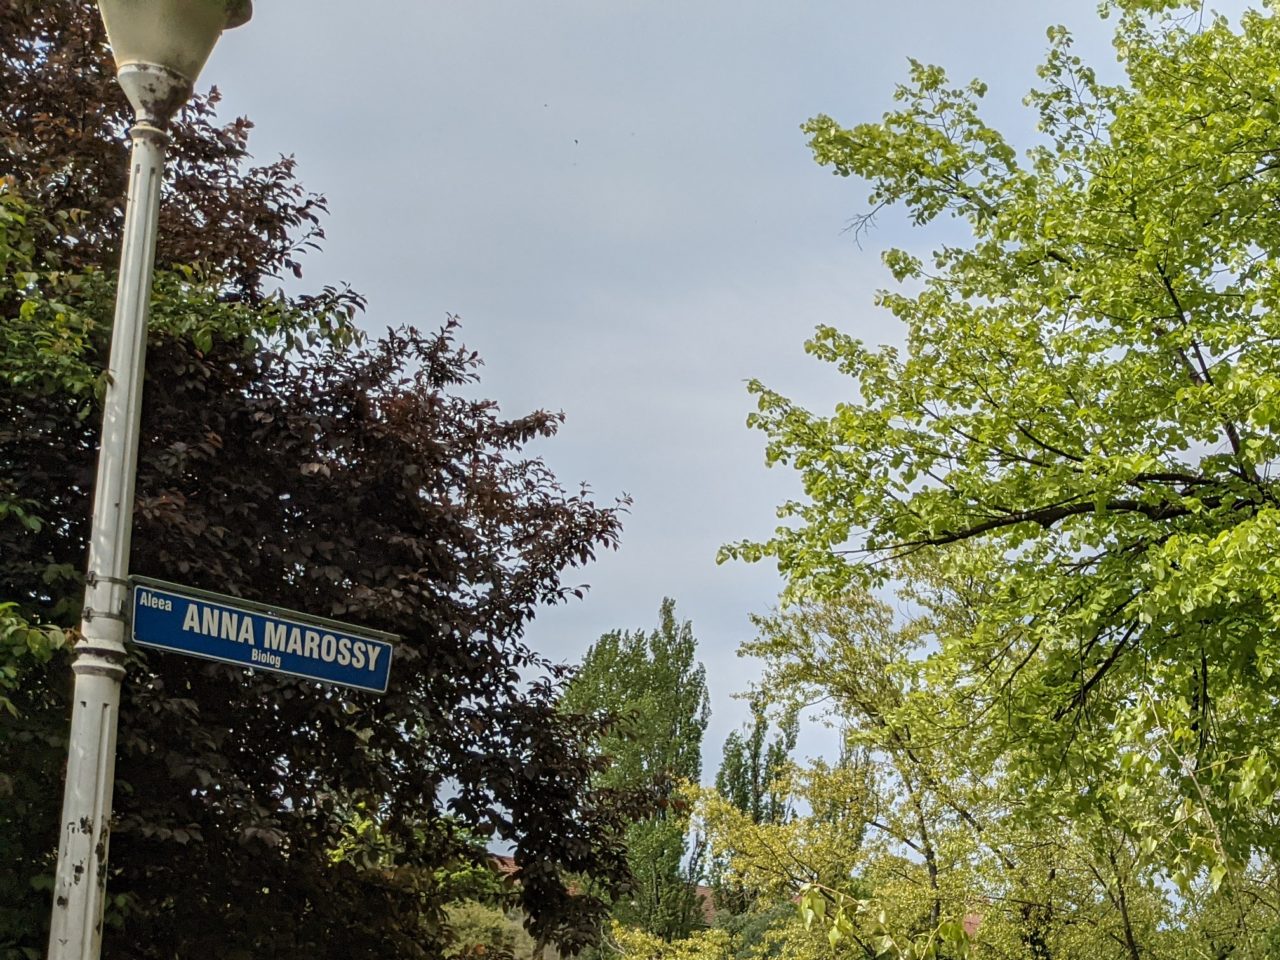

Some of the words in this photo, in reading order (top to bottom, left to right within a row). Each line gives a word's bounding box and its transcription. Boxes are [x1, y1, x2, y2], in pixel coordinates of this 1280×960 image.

[140, 591, 172, 611] Aleea
[182, 603, 255, 645] ANNA
[263, 621, 382, 671] MAROSSY
[251, 648, 281, 668] Biolog
